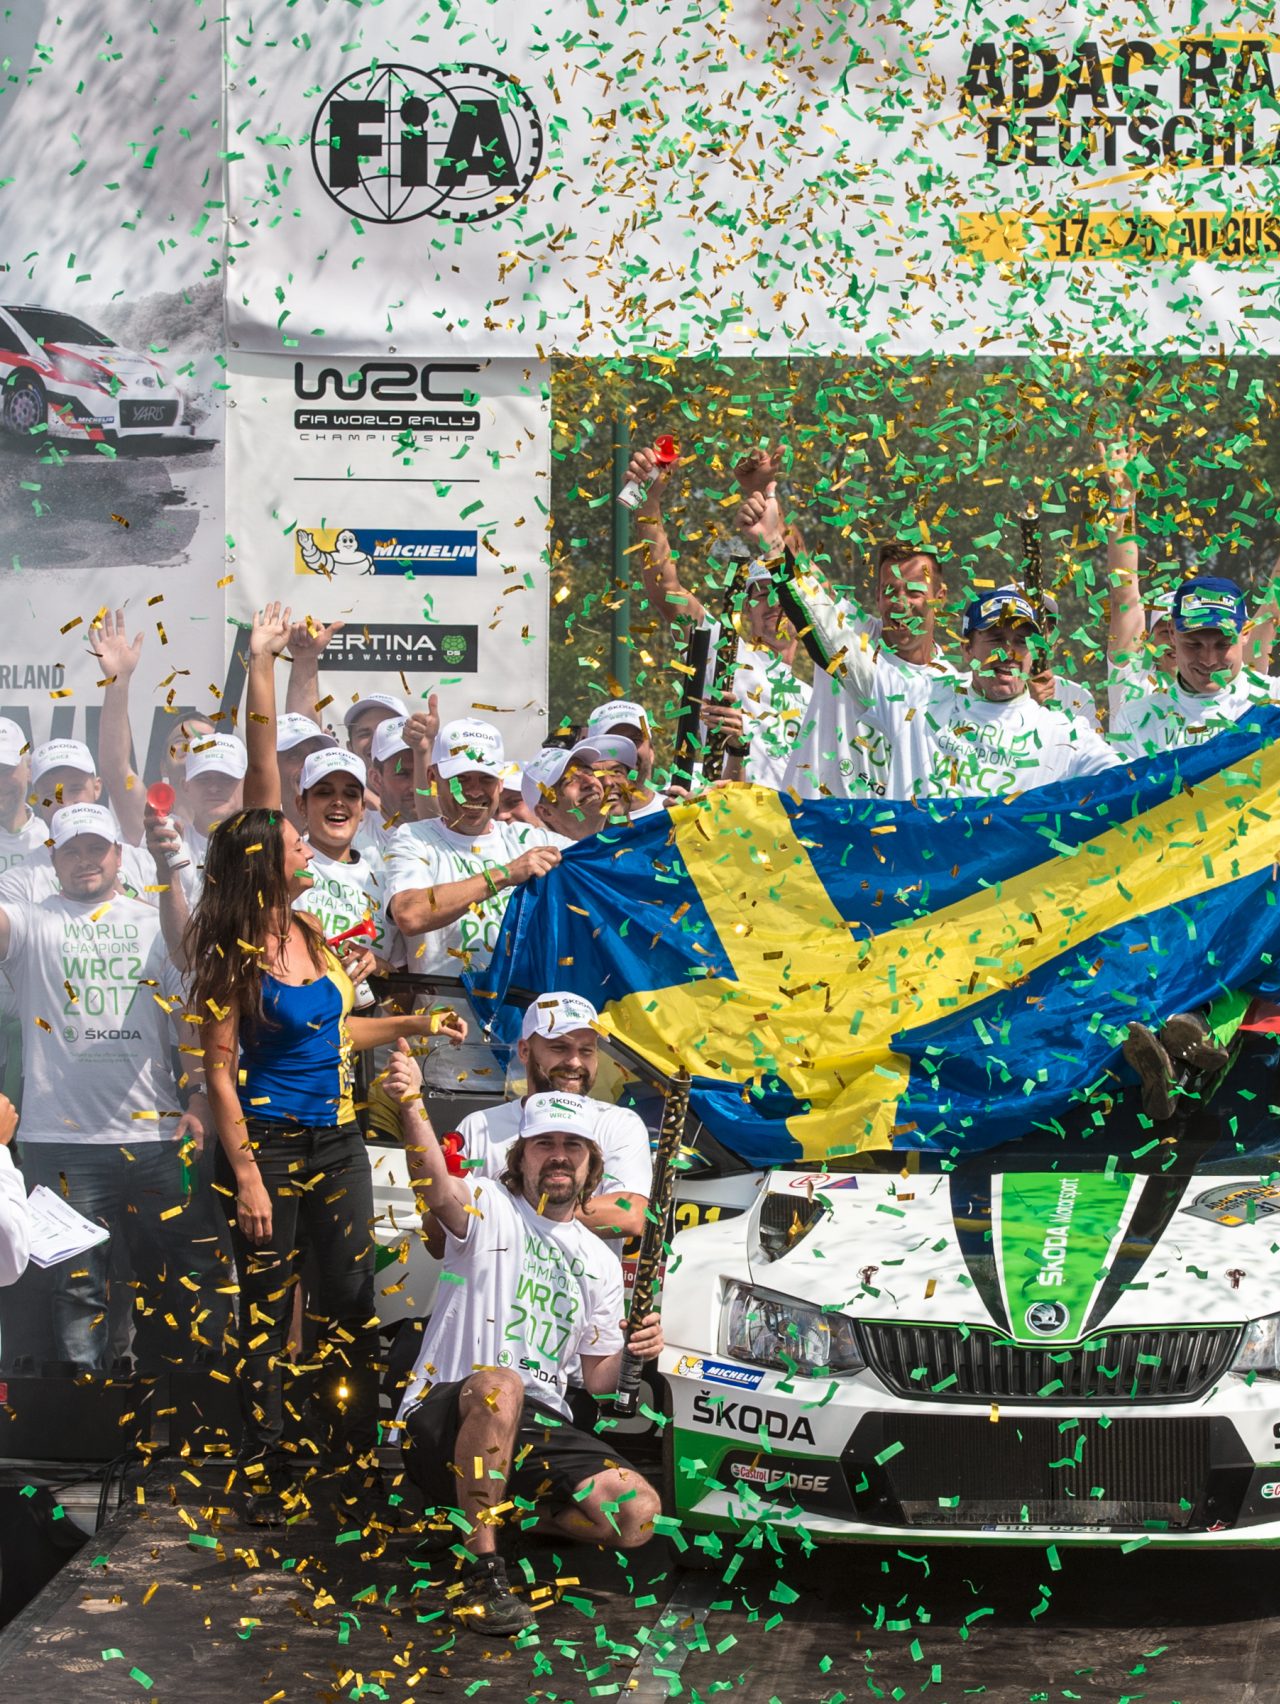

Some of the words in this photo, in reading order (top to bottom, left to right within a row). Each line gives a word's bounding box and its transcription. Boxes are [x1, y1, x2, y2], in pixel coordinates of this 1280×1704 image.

[959, 41, 1159, 109] ADAC
[294, 362, 481, 402] WRC
[133, 406, 166, 421] YARIS
[300, 415, 327, 425] FIA
[333, 415, 402, 426] WORLD
[408, 416, 475, 427] RALLY
[300, 433, 475, 442] CHAMPIOSHIP
[374, 545, 477, 558] MICHELIN
[326, 634, 437, 651] ERTINA
[64, 923, 139, 941] WORLD
[63, 957, 142, 980] WRC2
[84, 1028, 142, 1040] ŠKODA
[515, 1274, 579, 1325] WRC2
[707, 1366, 764, 1384] MICHELIN
[692, 1390, 816, 1446] ŠKODA
[740, 1466, 768, 1482] Castrol
